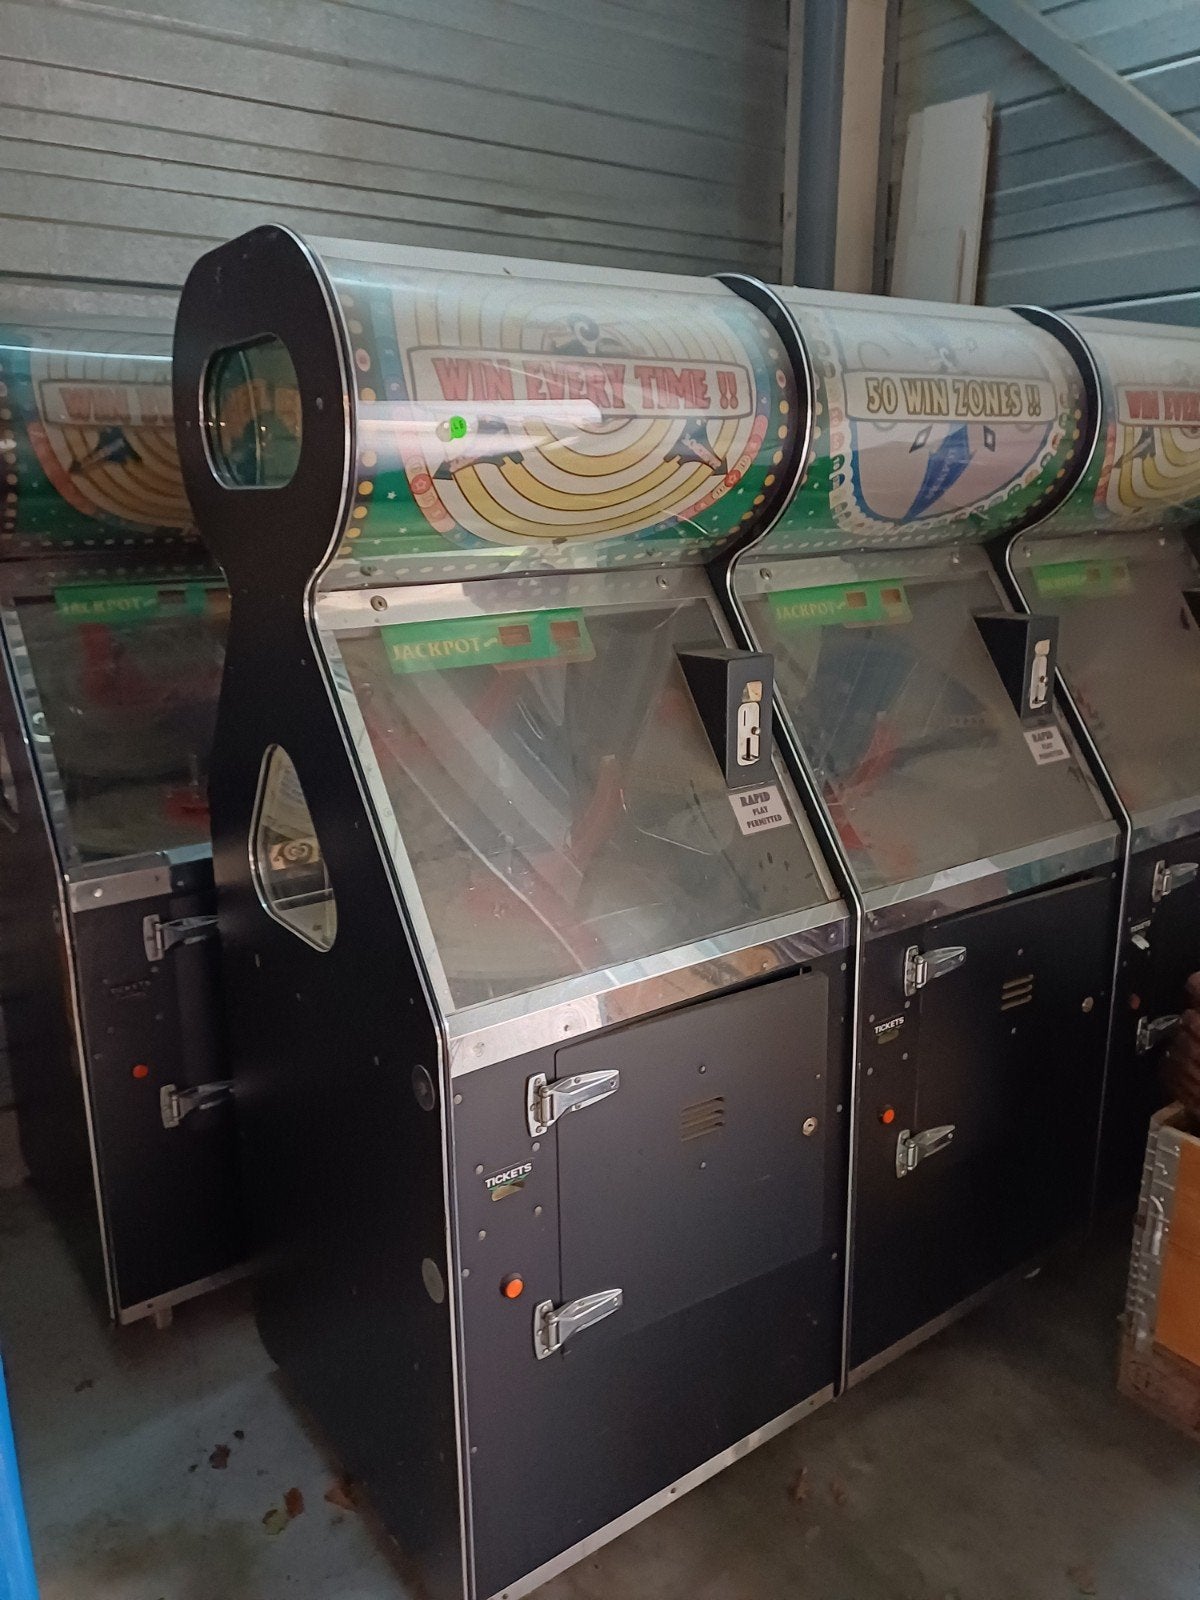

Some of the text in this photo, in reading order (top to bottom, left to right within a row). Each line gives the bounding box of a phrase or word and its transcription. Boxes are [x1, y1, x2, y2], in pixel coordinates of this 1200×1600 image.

[432, 357, 514, 401] WIN
[523, 360, 626, 409] EVERY
[634, 365, 711, 410] TIME
[865, 377, 898, 413] 50
[901, 377, 949, 417] WIN
[951, 378, 1023, 418] ZONES
[775, 601, 835, 620] JACKPOT
[392, 637, 482, 661] JACKPOT
[740, 792, 770, 807] RAPID
[752, 805, 769, 816] PLAY
[747, 814, 782, 828] PERMITTED
[874, 1016, 904, 1034] TICKETS
[485, 1162, 532, 1188] TICKETS
